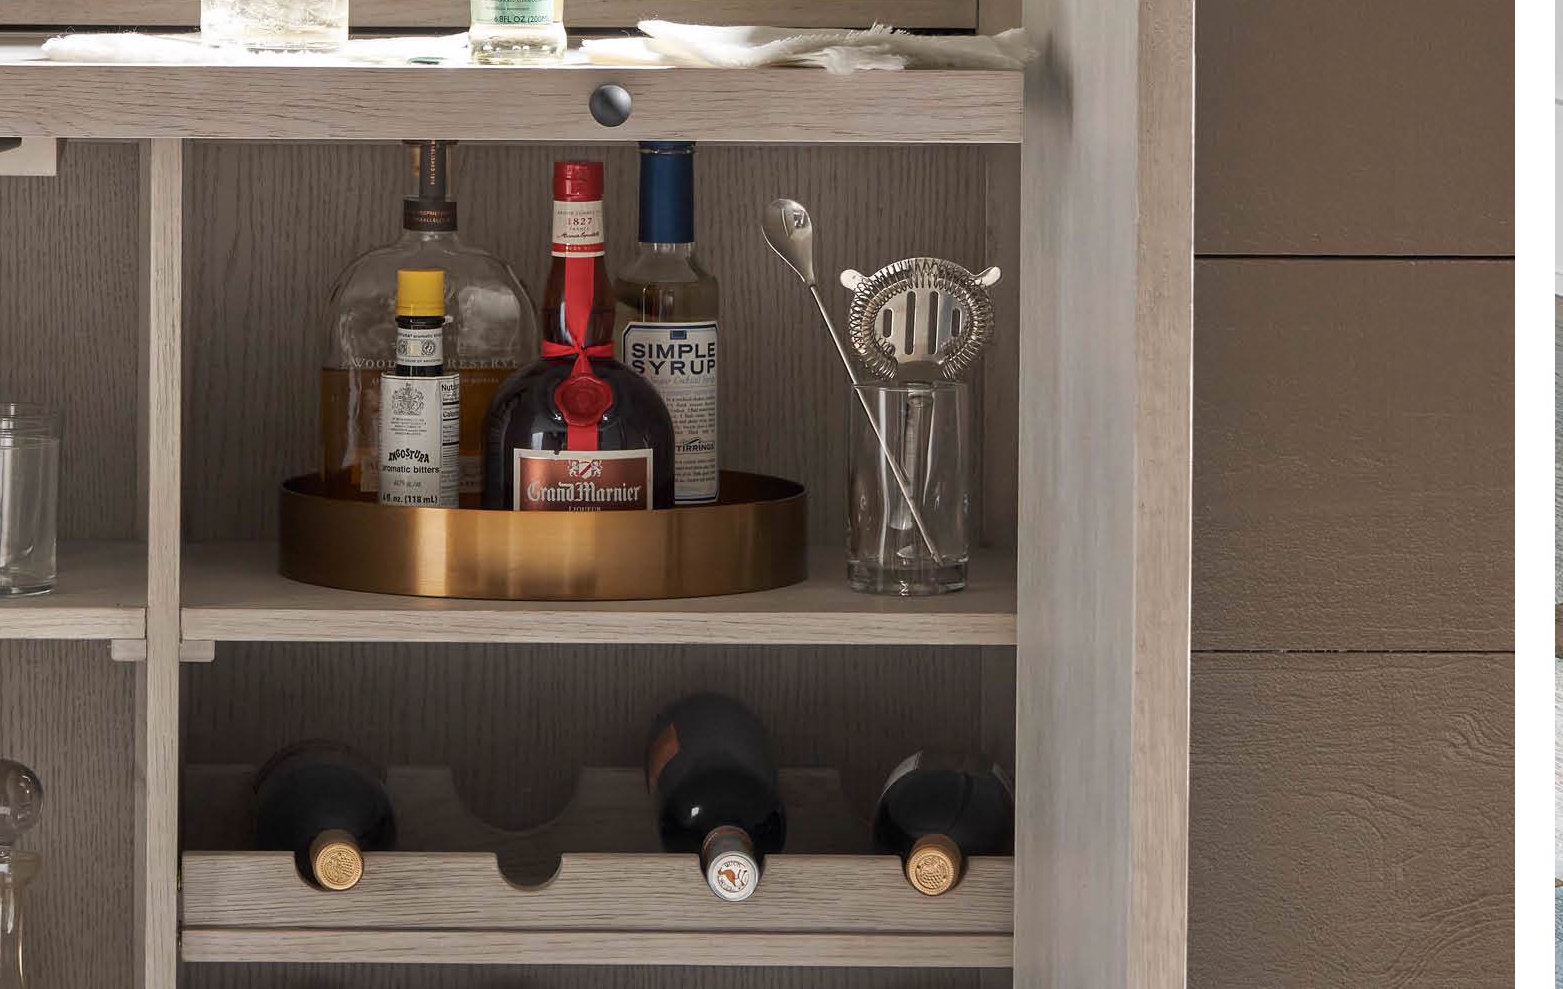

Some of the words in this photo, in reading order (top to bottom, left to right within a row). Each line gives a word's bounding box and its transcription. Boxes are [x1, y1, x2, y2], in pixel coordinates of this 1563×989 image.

[568, 217, 593, 226] 1827
[632, 342, 716, 359] SIMPLE
[447, 357, 518, 370] RESERVE
[632, 359, 716, 375] SYRUP
[675, 443, 715, 452] TIRRINGS
[388, 448, 430, 463] ANGOSTURA
[413, 466, 441, 474] bitters
[527, 482, 575, 501] Grand
[575, 482, 641, 501] Marnier
[405, 495, 422, 504] (118
[423, 496, 438, 504] mL)
